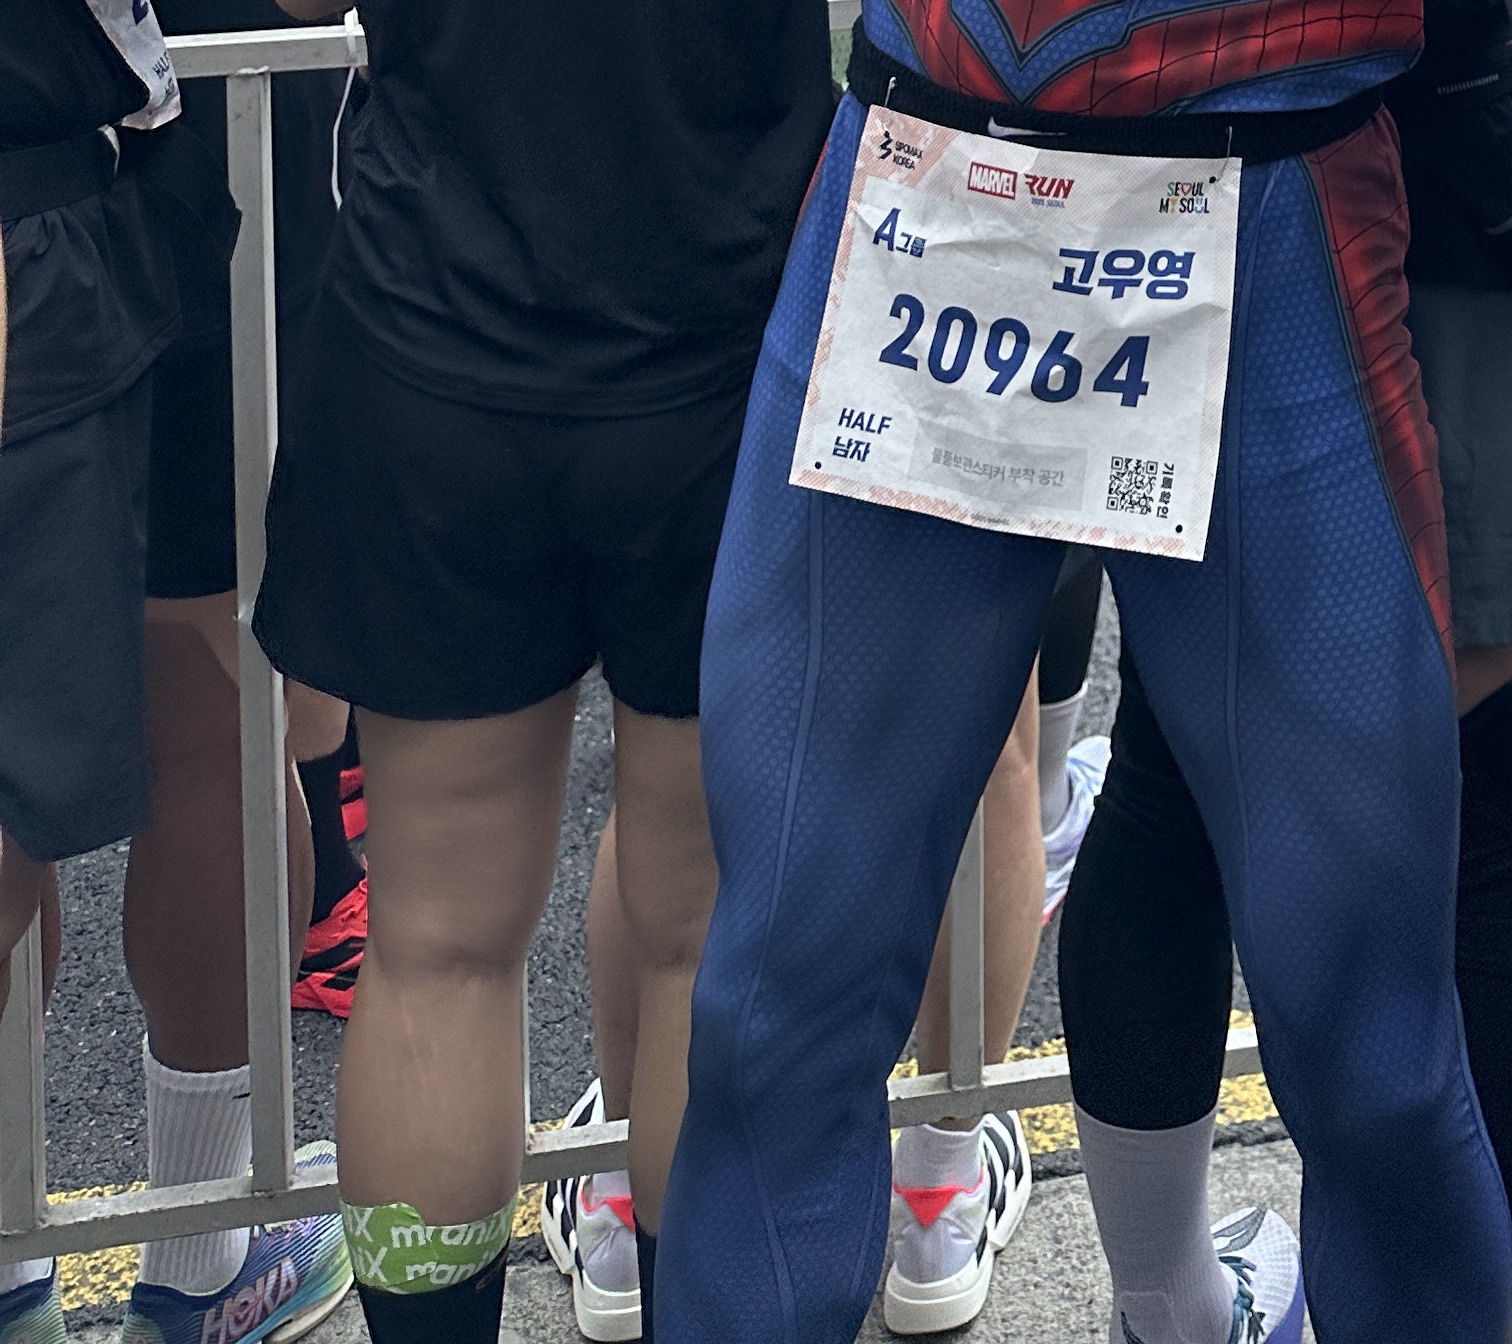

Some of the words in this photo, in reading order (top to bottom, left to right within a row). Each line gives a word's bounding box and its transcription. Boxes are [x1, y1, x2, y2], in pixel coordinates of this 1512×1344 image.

[892, 154, 916, 171] KOREA
[895, 141, 924, 159] SPOMAX
[970, 164, 1016, 199] MARVEL
[1024, 173, 1074, 199] RUN
[1052, 248, 1196, 300] 고우영
[879, 293, 1150, 408] 20964
[838, 408, 893, 435] HALF
[832, 436, 871, 462] 남자
[1008, 466, 1035, 485] 부착
[1038, 468, 1065, 487] 공간
[201, 1256, 299, 1344] HOKA
